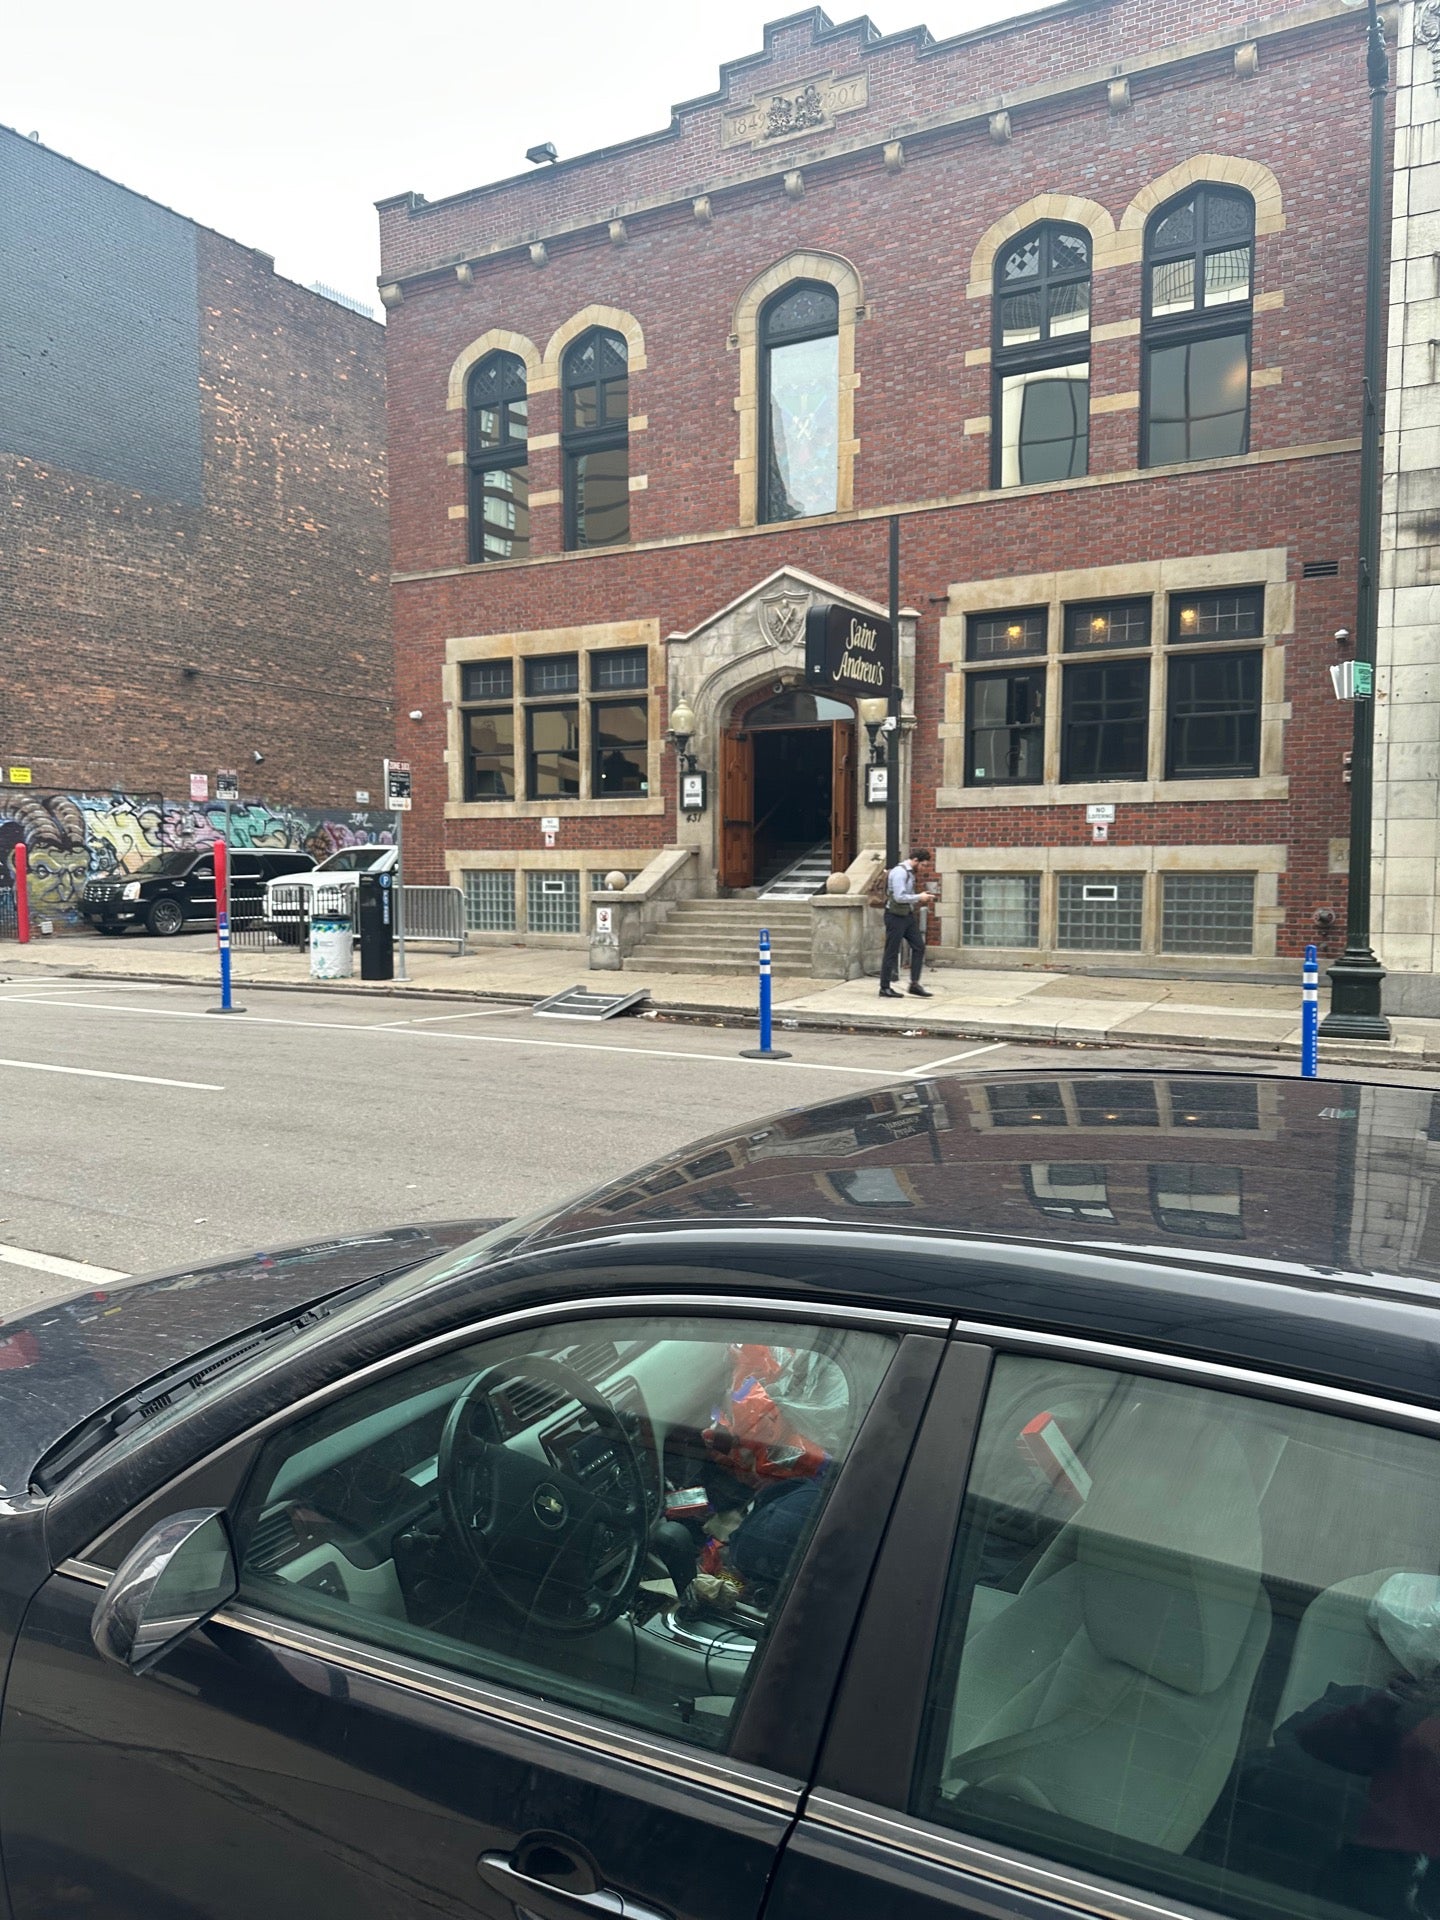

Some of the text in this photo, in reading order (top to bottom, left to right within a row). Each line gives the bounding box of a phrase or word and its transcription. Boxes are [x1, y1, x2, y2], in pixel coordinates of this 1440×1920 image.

[823, 83, 858, 109] 1907
[732, 113, 766, 135] 1849
[845, 617, 877, 652] Saint
[832, 651, 885, 686] Andrew's
[686, 813, 702, 823] 431
